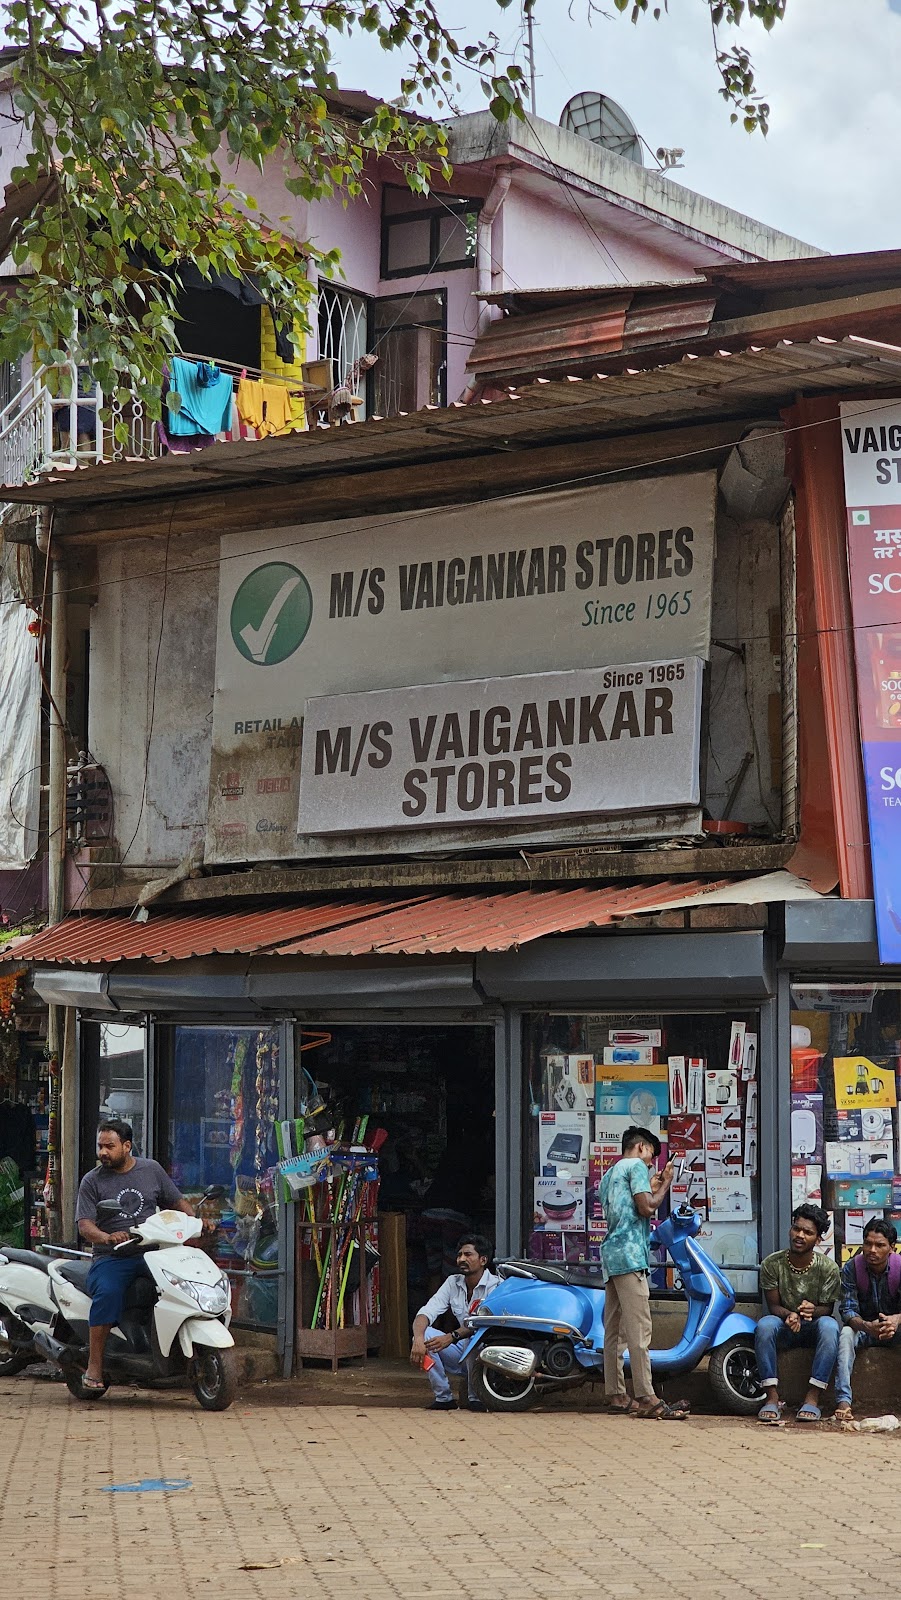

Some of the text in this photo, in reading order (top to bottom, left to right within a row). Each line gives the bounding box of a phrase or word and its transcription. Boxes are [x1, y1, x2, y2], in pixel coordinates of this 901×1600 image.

[843, 424, 901, 454] VAIG
[872, 547, 896, 559] तर
[328, 526, 694, 619] M/S VAIGANKAR STORES
[581, 589, 693, 627] Since 1965
[603, 663, 685, 689] Since 1965
[234, 718, 285, 735] RETAIL
[314, 687, 674, 777] M/S VAIGANKAR
[402, 752, 572, 818] STORES
